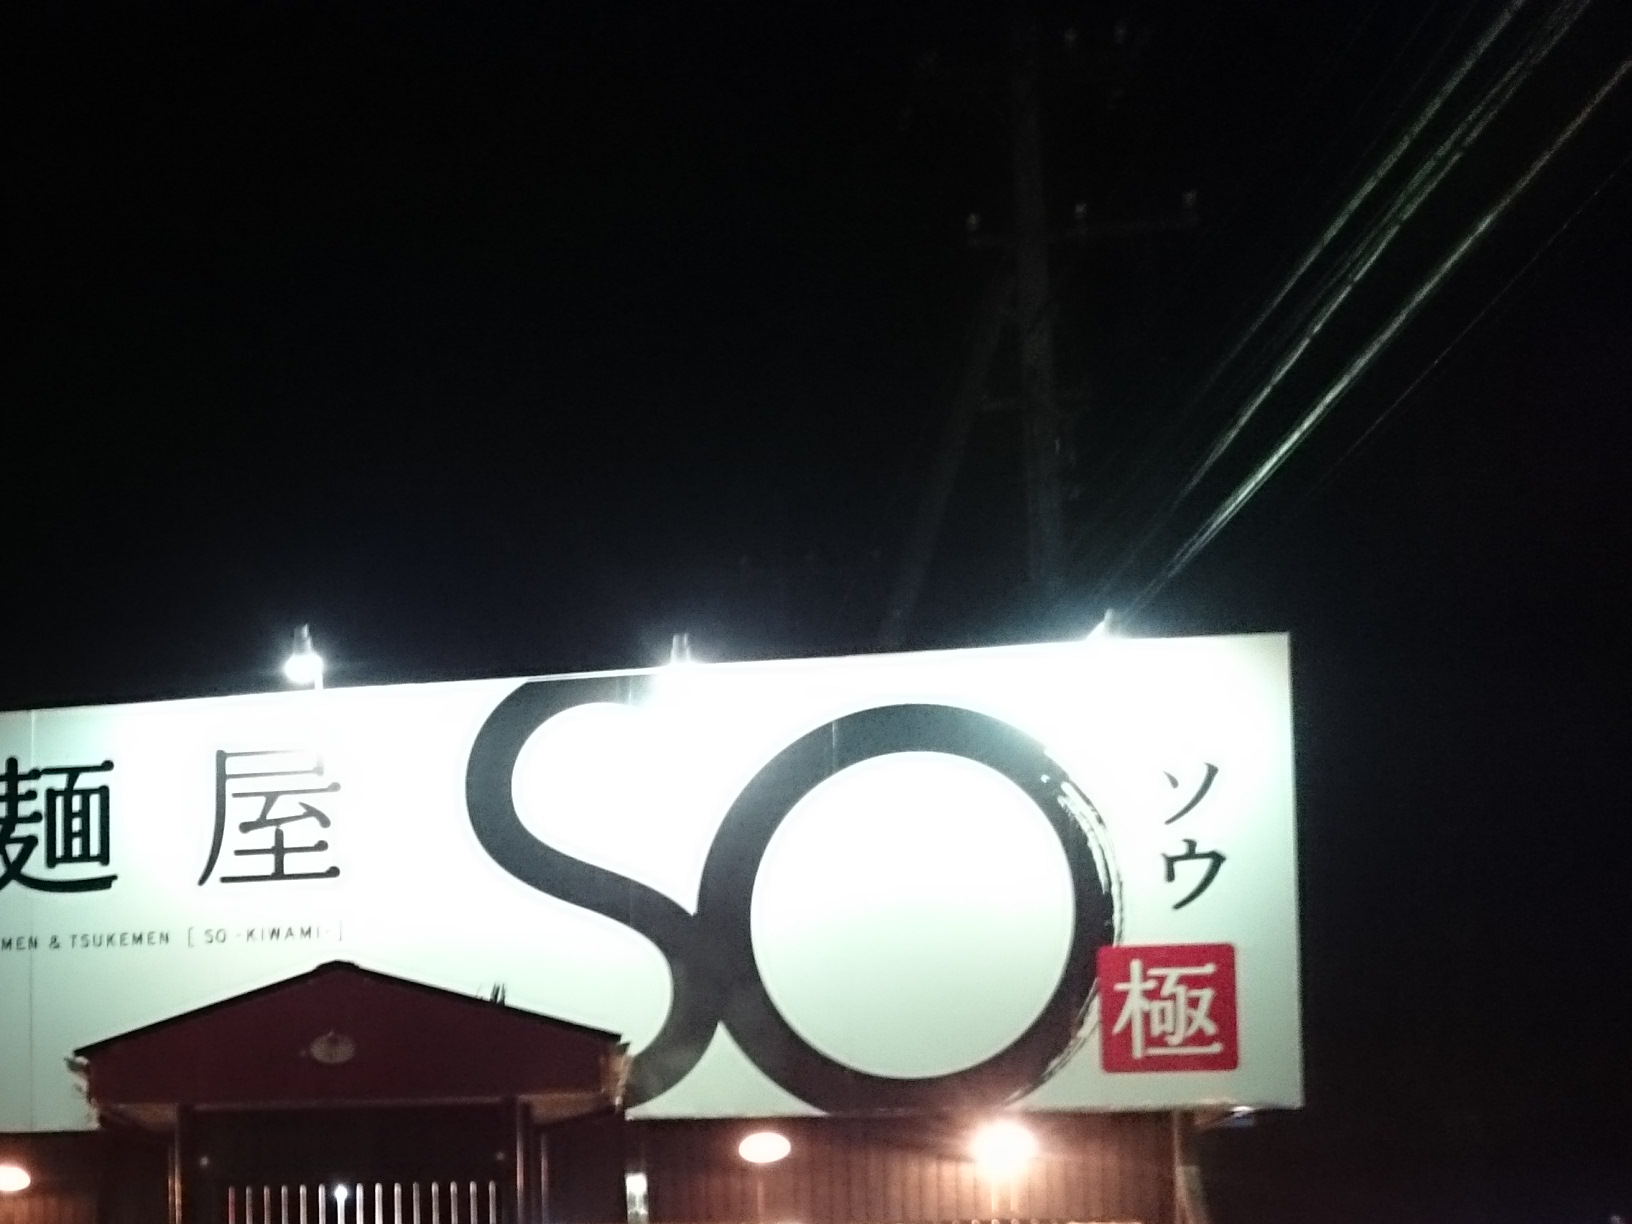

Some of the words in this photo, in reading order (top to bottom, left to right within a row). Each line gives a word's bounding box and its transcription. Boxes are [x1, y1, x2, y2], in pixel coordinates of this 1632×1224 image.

[465, 675, 1124, 1118] SO
[1161, 762, 1227, 910] ソウ
[49, 935, 61, 949] &
[69, 931, 170, 949] TSUKEMEN
[1111, 957, 1225, 1060] 極
